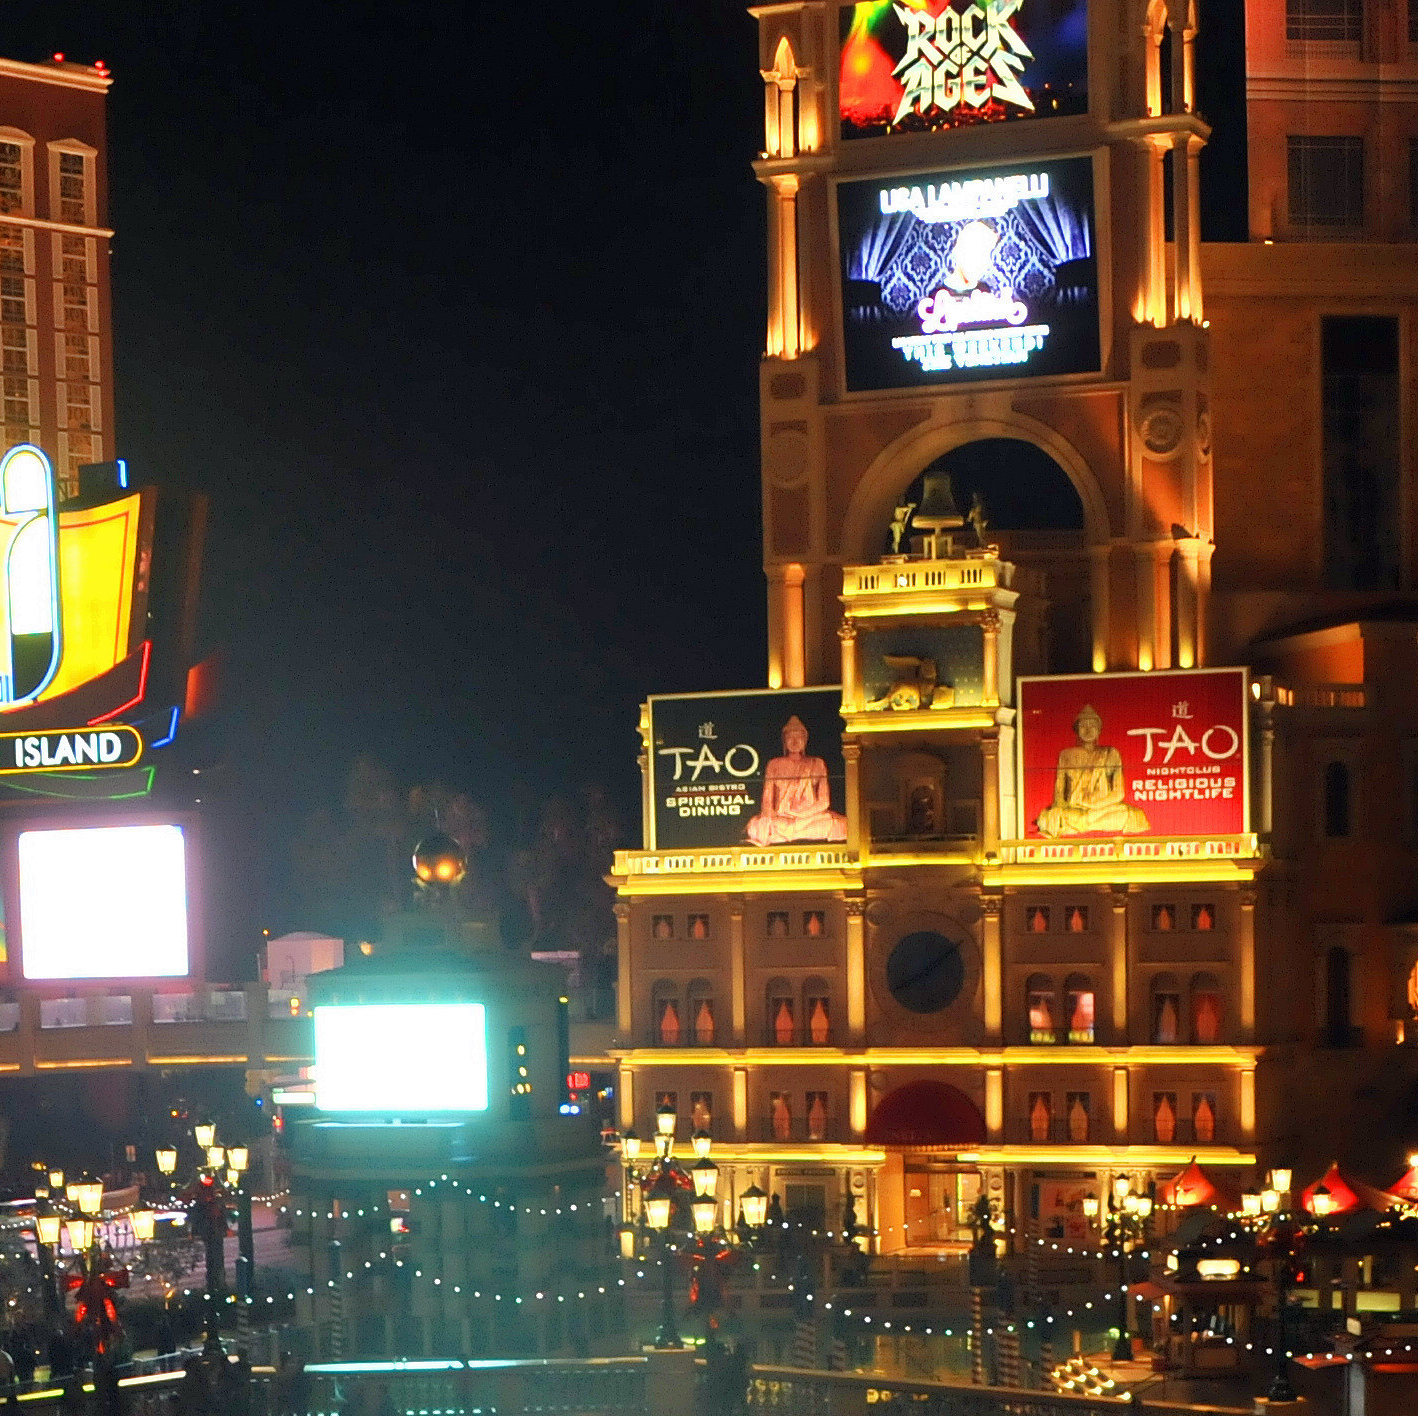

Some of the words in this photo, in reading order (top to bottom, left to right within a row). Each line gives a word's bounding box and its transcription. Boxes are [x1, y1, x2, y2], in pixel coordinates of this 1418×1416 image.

[891, 0, 1035, 76] ROCK
[949, 45, 972, 65] OF
[892, 49, 1035, 125] AGES
[15, 731, 122, 766] ISLAND
[1127, 724, 1239, 764] TAO
[658, 744, 759, 781] TAO
[1147, 766, 1221, 775] NIGHTCLUB
[708, 783, 746, 791] BISTRO
[1132, 777, 1236, 790] RELIGIOUS
[666, 795, 755, 807] SPIRITUAL
[1134, 788, 1234, 801] NIGHTLIFE
[679, 805, 741, 817] DINING
